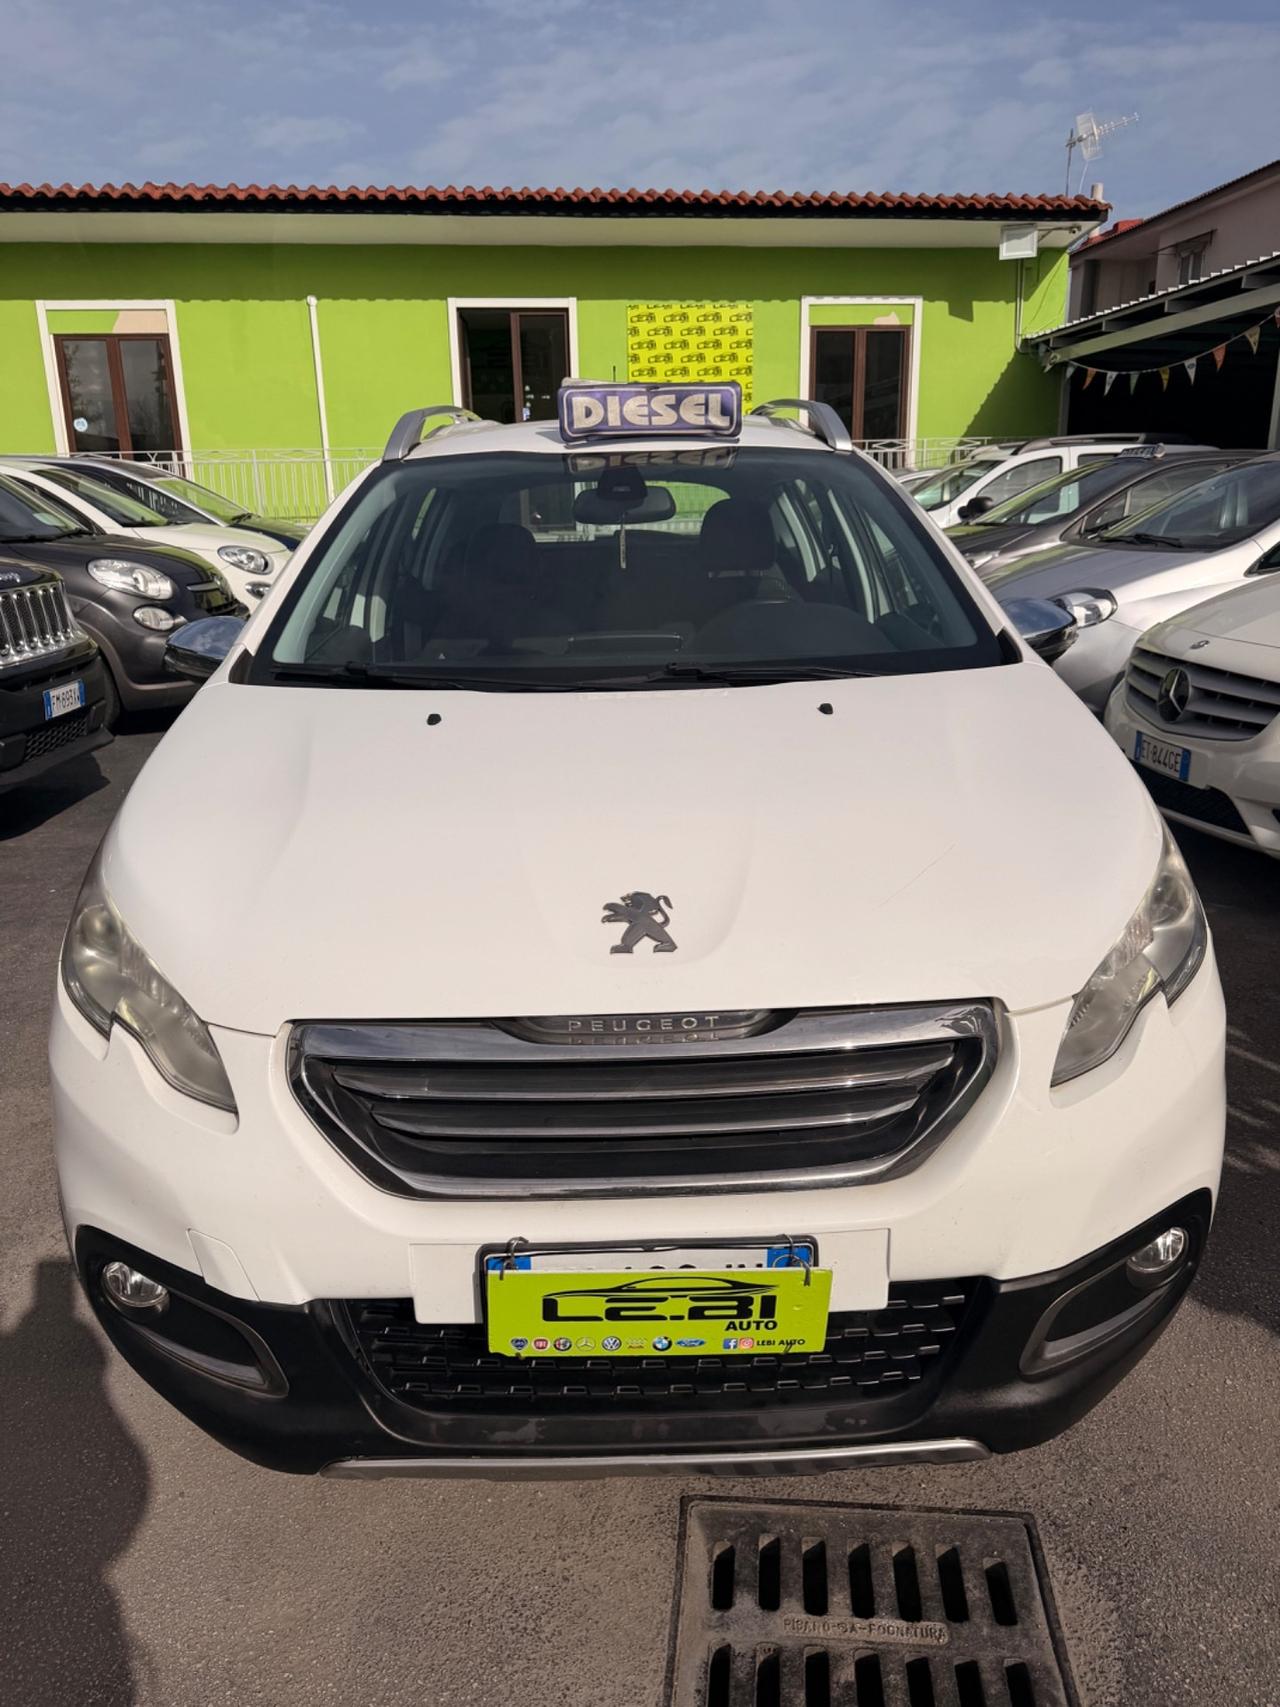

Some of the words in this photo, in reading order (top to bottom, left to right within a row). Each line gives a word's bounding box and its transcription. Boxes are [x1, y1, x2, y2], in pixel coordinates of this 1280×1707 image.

[572, 393, 731, 429] DIESEL
[568, 1015, 720, 1032] PEUGEOT
[724, 1320, 778, 1332] AUTO
[778, 1338, 806, 1346] AUTO
